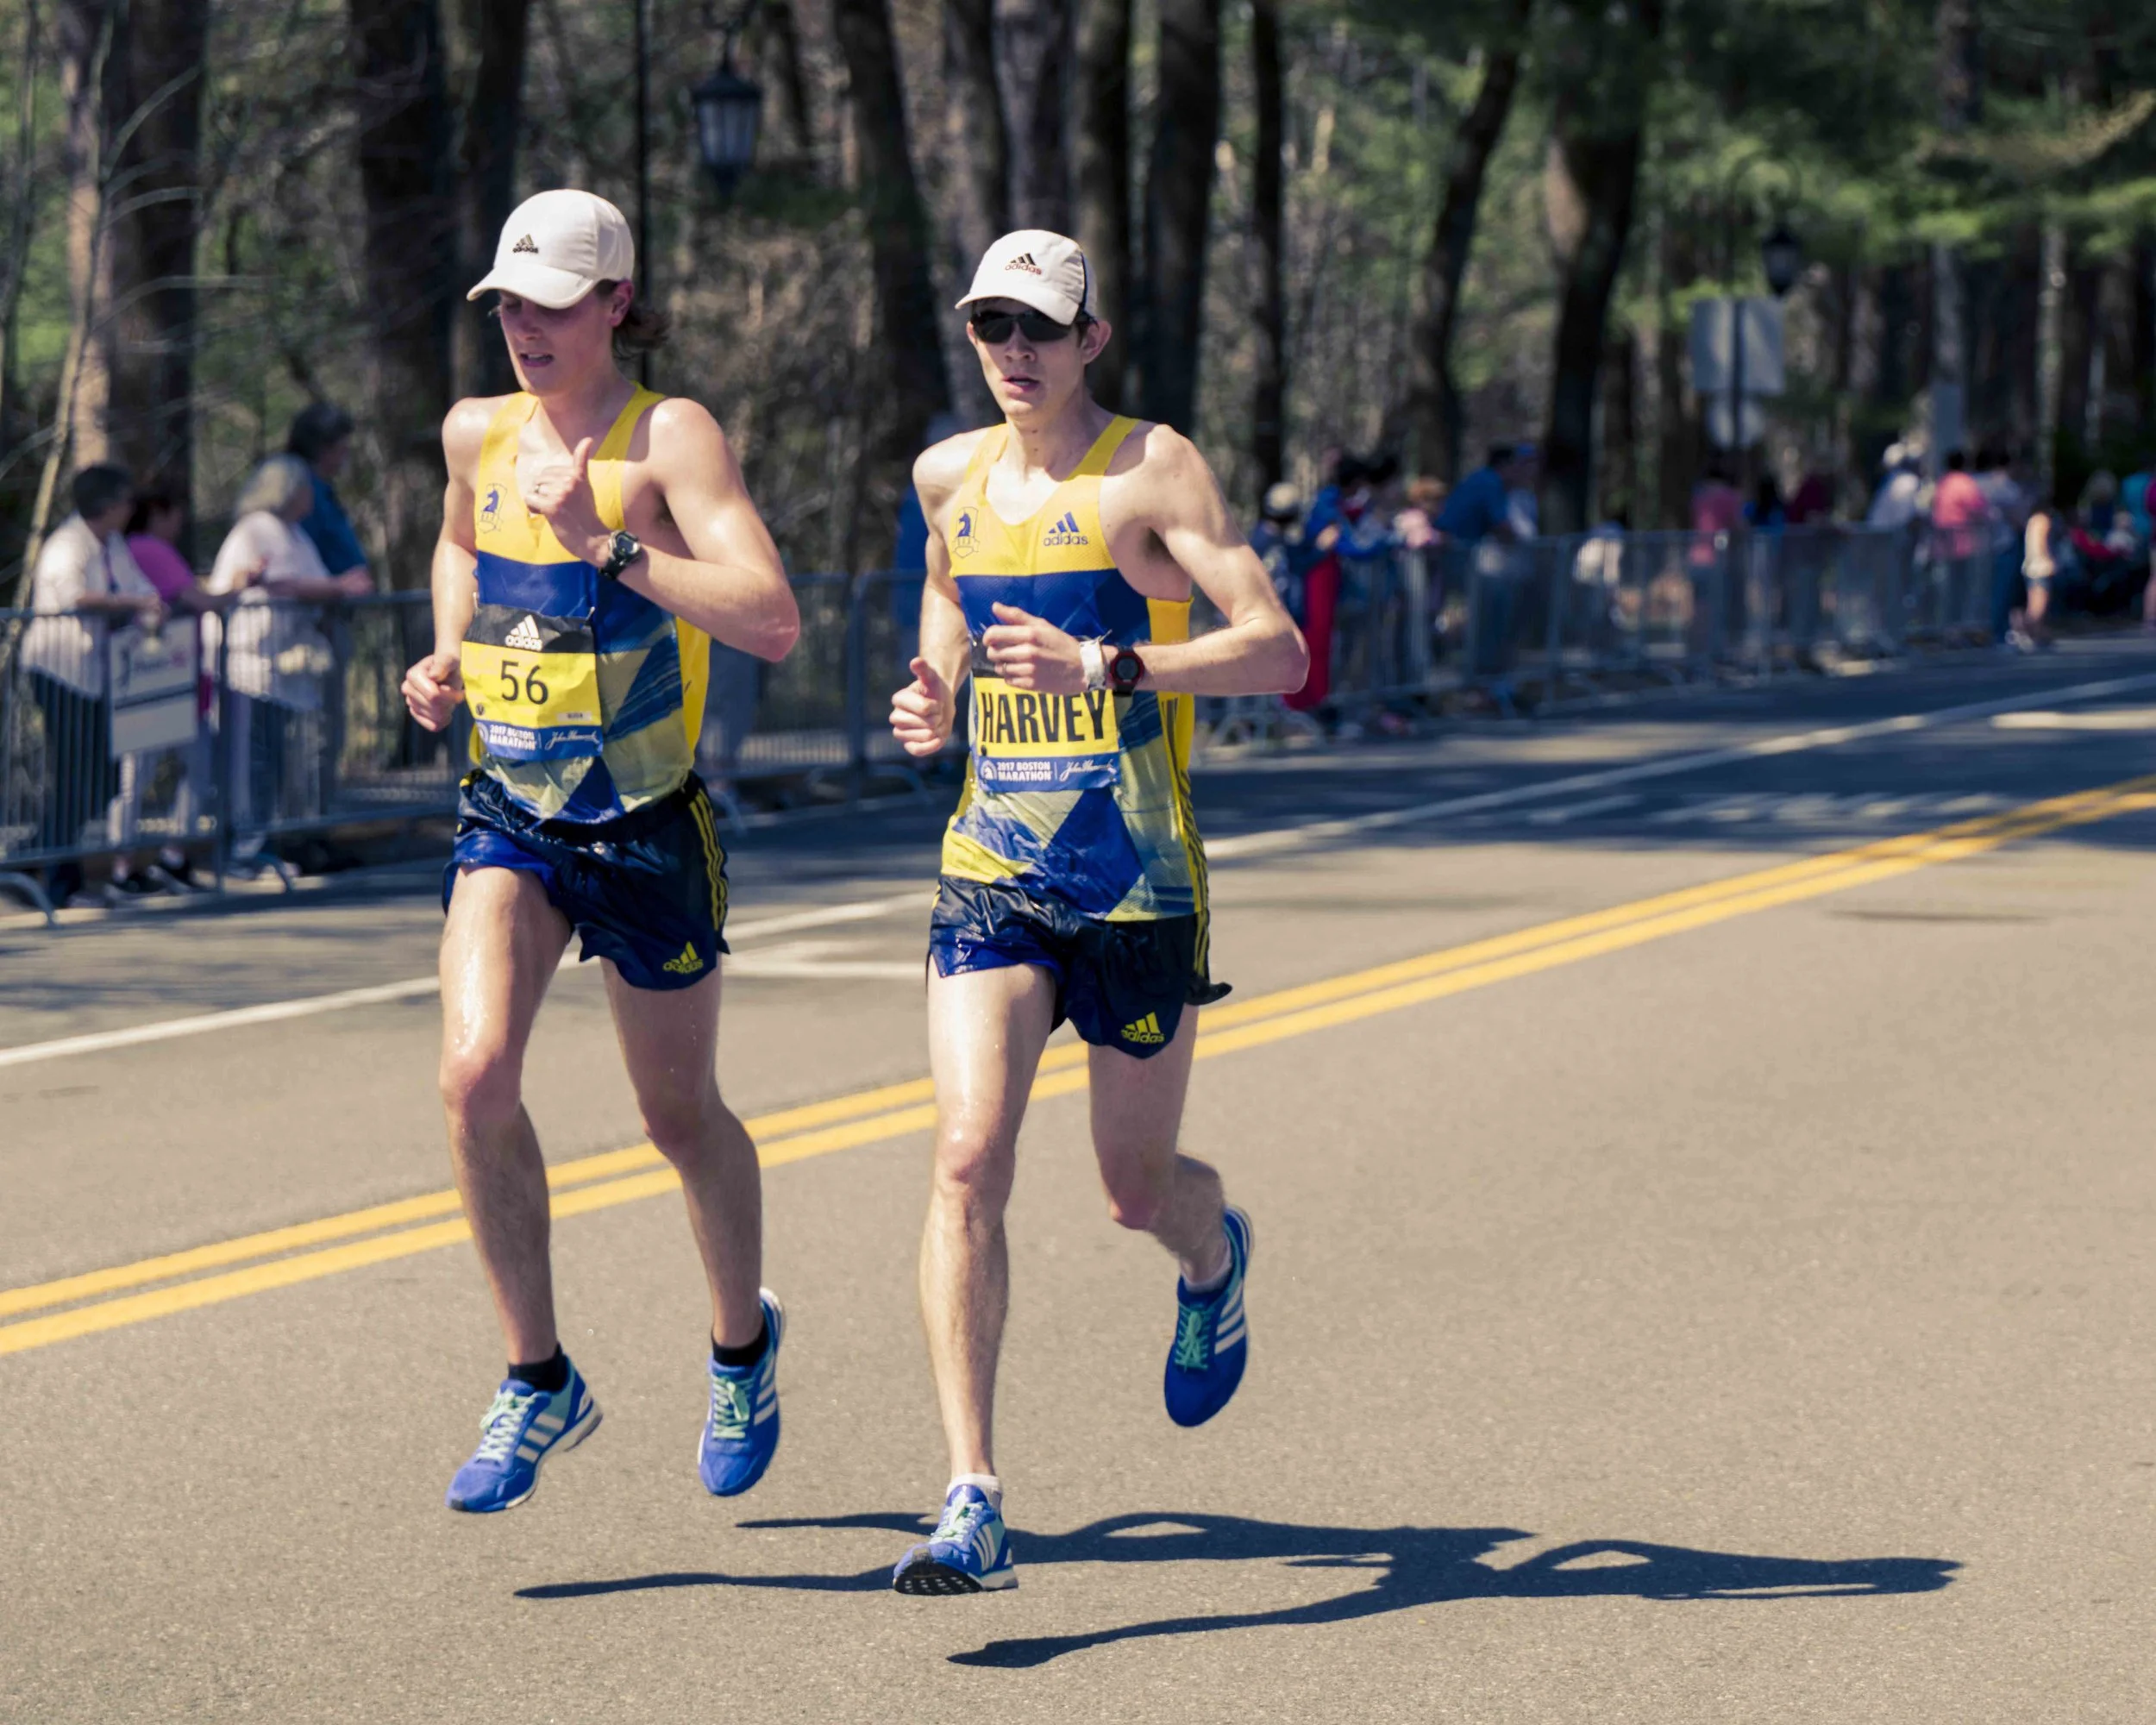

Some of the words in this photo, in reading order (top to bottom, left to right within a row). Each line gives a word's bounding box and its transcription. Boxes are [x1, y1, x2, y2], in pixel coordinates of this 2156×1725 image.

[1005, 262, 1042, 275] adidas
[1043, 533, 1088, 546] adidas
[505, 633, 542, 651] adidas
[501, 660, 549, 705] 56
[981, 690, 1106, 743] HARVEY
[489, 724, 507, 735] 2017
[489, 734, 536, 750] MARATHON
[997, 761, 1015, 771] 2017
[1017, 761, 1051, 772] BOSTON
[998, 771, 1052, 781] MARATHON
[662, 958, 704, 974] adidas
[1121, 1029, 1165, 1044] adidas
